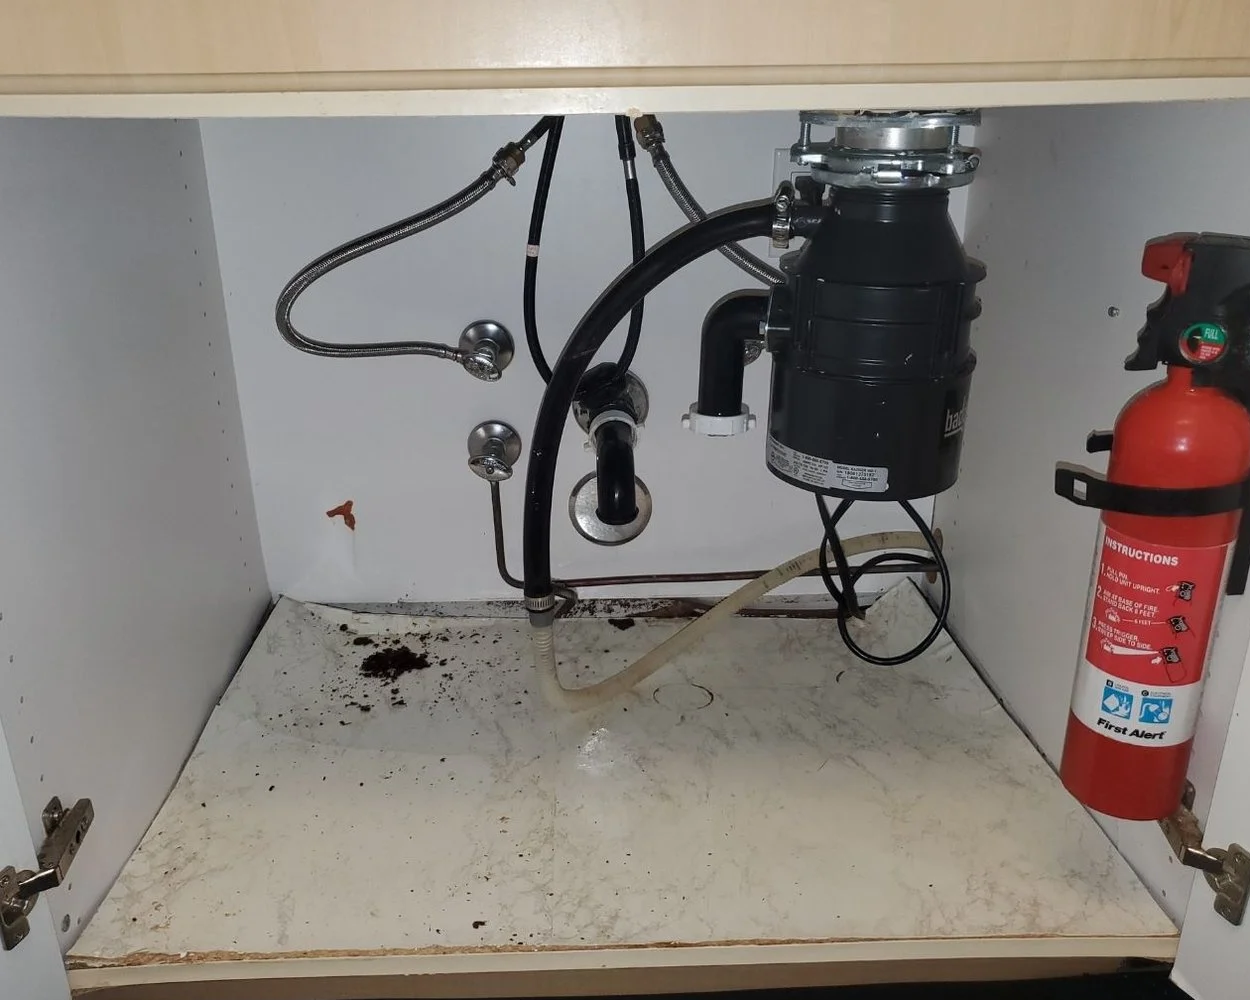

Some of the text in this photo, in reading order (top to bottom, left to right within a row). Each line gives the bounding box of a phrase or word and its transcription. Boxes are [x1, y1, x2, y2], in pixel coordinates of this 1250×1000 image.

[1204, 328, 1218, 340] FULL
[1105, 536, 1179, 566] INSTRUCTIONS
[1119, 578, 1132, 588] UNIT
[1118, 595, 1133, 607] BASE
[1134, 601, 1142, 609] OF
[1118, 602, 1134, 614] BACK
[1113, 634, 1126, 644] SIDE
[1097, 718, 1165, 740] First Alert
